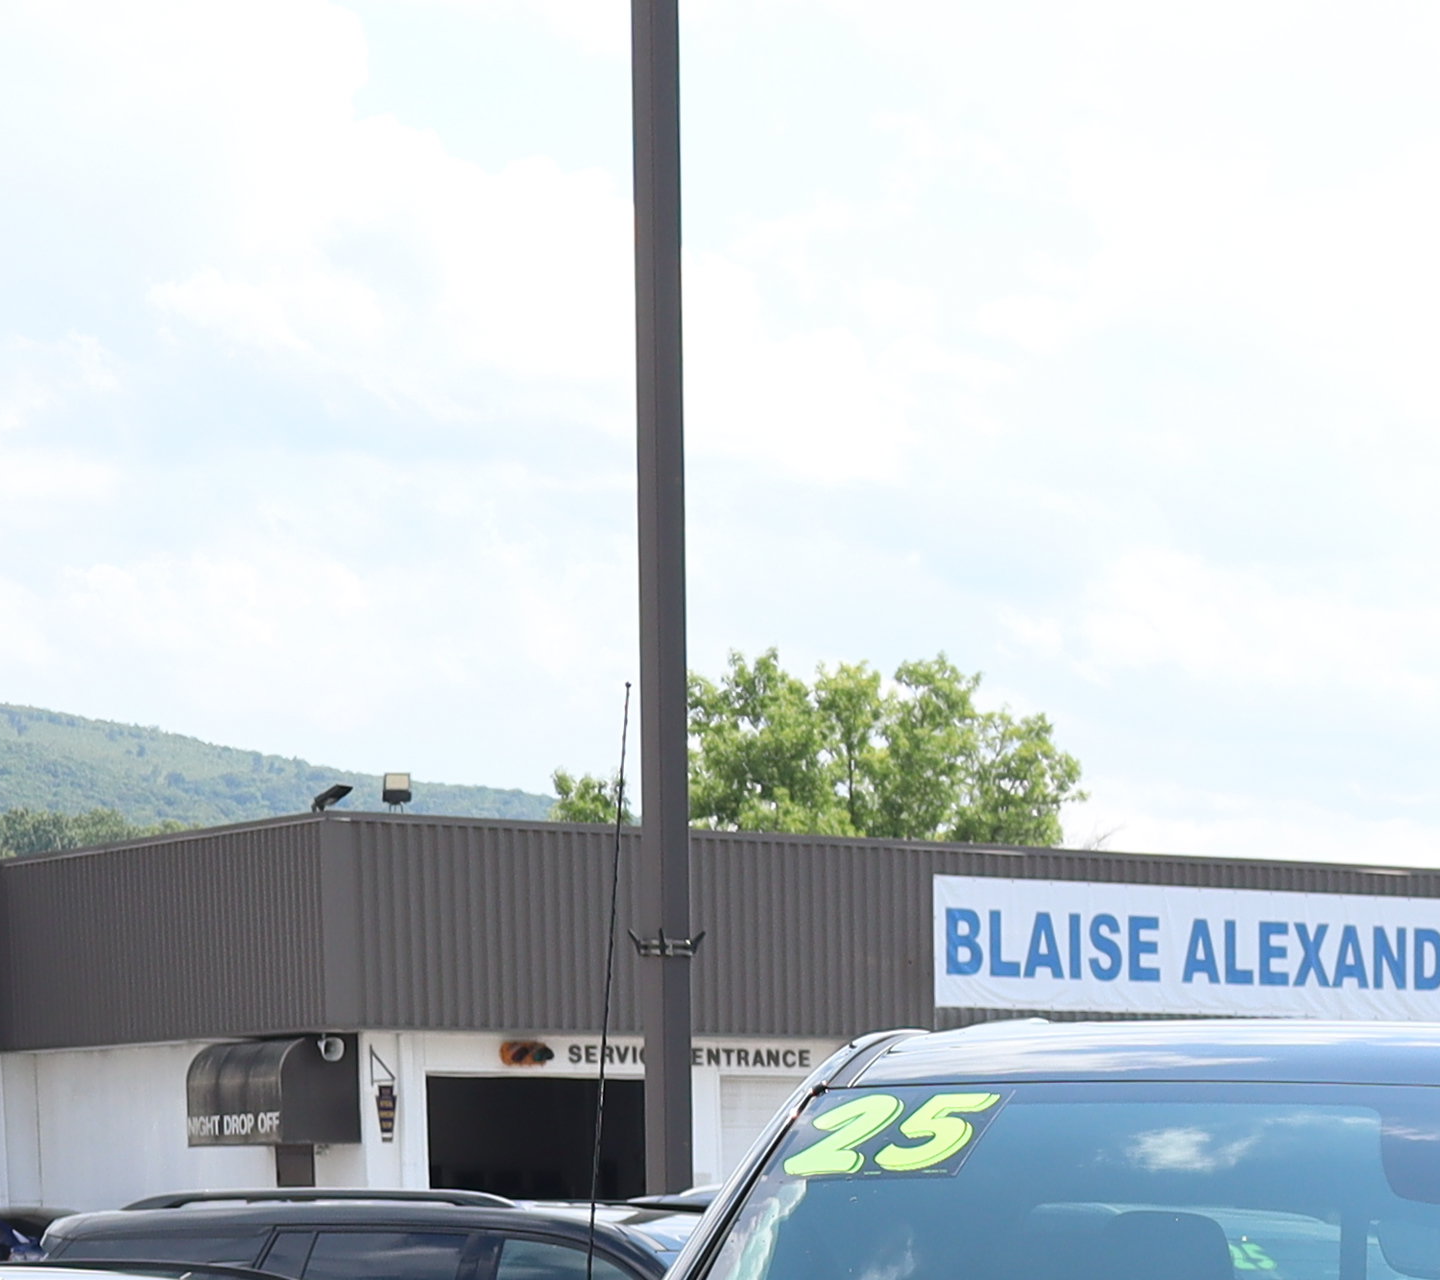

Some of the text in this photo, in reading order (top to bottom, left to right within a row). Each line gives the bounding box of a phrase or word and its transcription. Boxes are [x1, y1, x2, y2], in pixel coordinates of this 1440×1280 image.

[945, 907, 1160, 983] BLAISE
[568, 1044, 810, 1068] SERVI ENTRANCE
[188, 1111, 280, 1136] NIGHT DROP OFF
[783, 1093, 1001, 1176] 25
